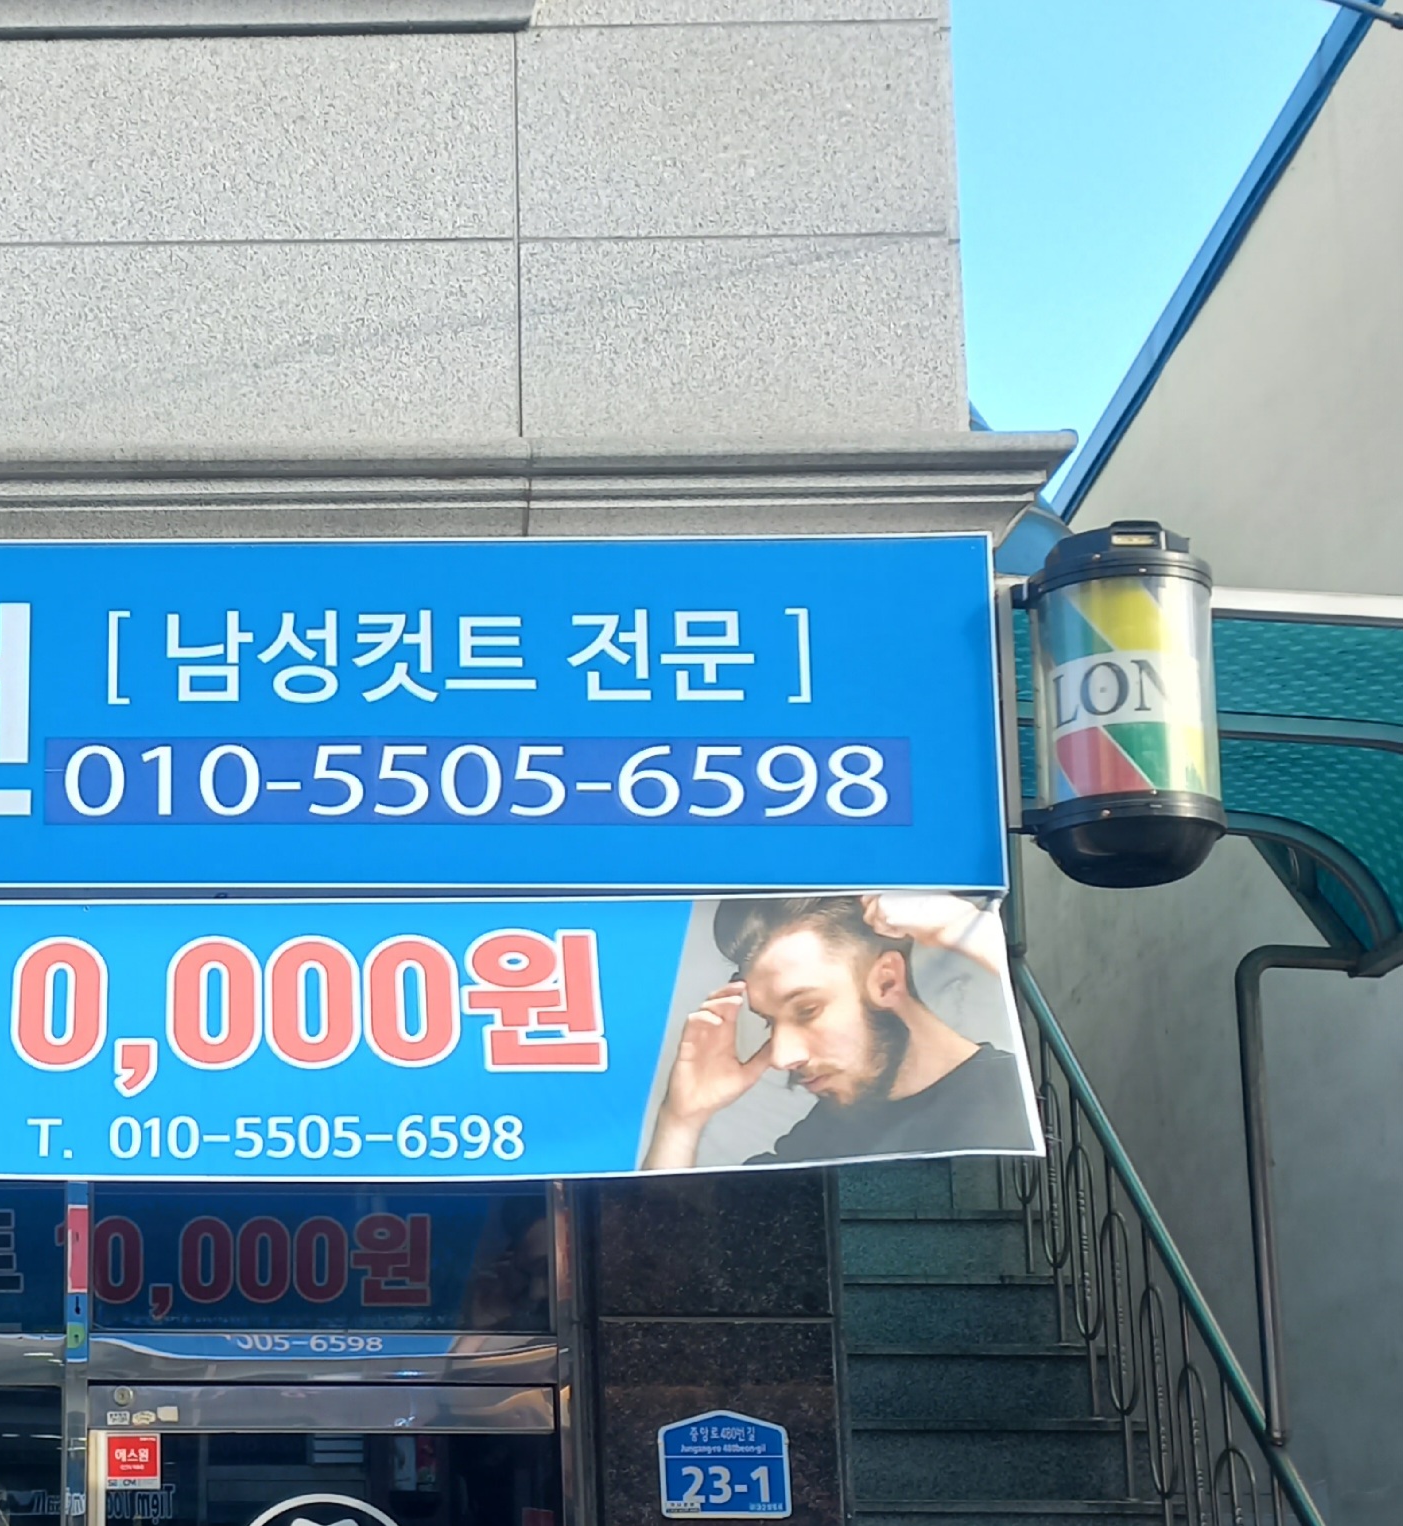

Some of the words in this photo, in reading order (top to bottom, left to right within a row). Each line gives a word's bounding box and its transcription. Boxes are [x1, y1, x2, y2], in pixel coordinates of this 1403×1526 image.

[166, 609, 537, 703] 남성컷트
[567, 609, 755, 704] 전문
[63, 743, 890, 818] 010-5505-6598
[27, 1117, 74, 1160] T.
[108, 1114, 525, 1162] 010-5505-6598
[681, 1465, 771, 1504] 23-1
